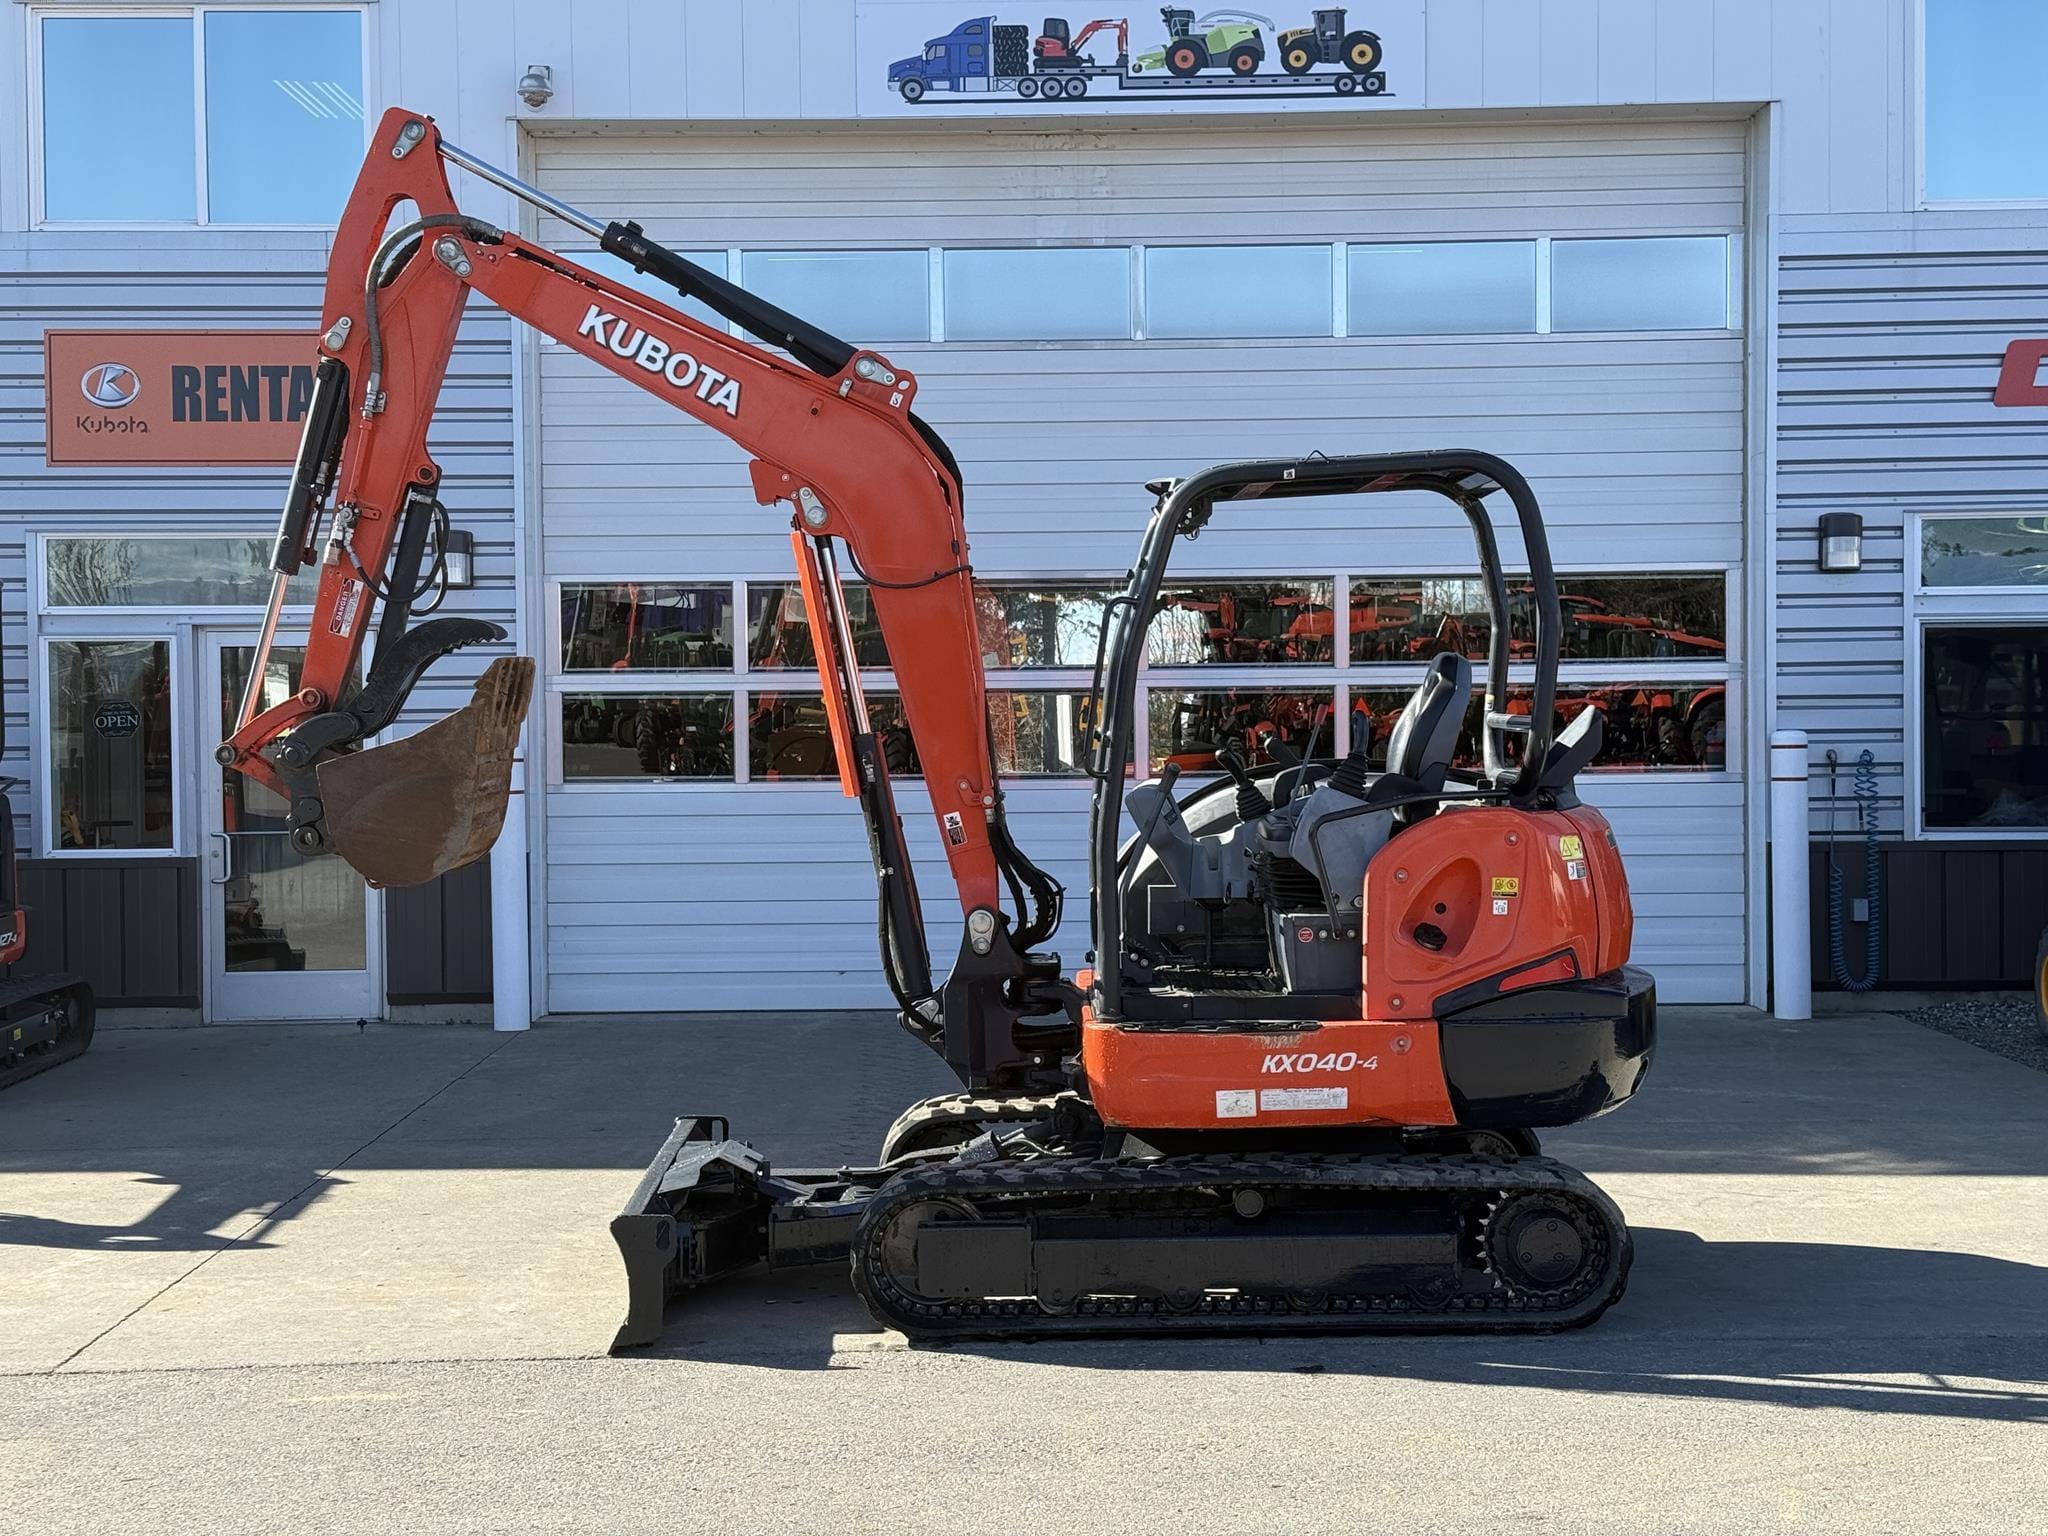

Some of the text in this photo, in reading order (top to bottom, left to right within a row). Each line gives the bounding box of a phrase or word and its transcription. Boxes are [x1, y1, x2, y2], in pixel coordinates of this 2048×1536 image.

[578, 303, 742, 418] KUBOTA
[76, 415, 150, 434] Kubota
[95, 715, 139, 728] OPEN
[1261, 1052, 1378, 1074] KX040-4
